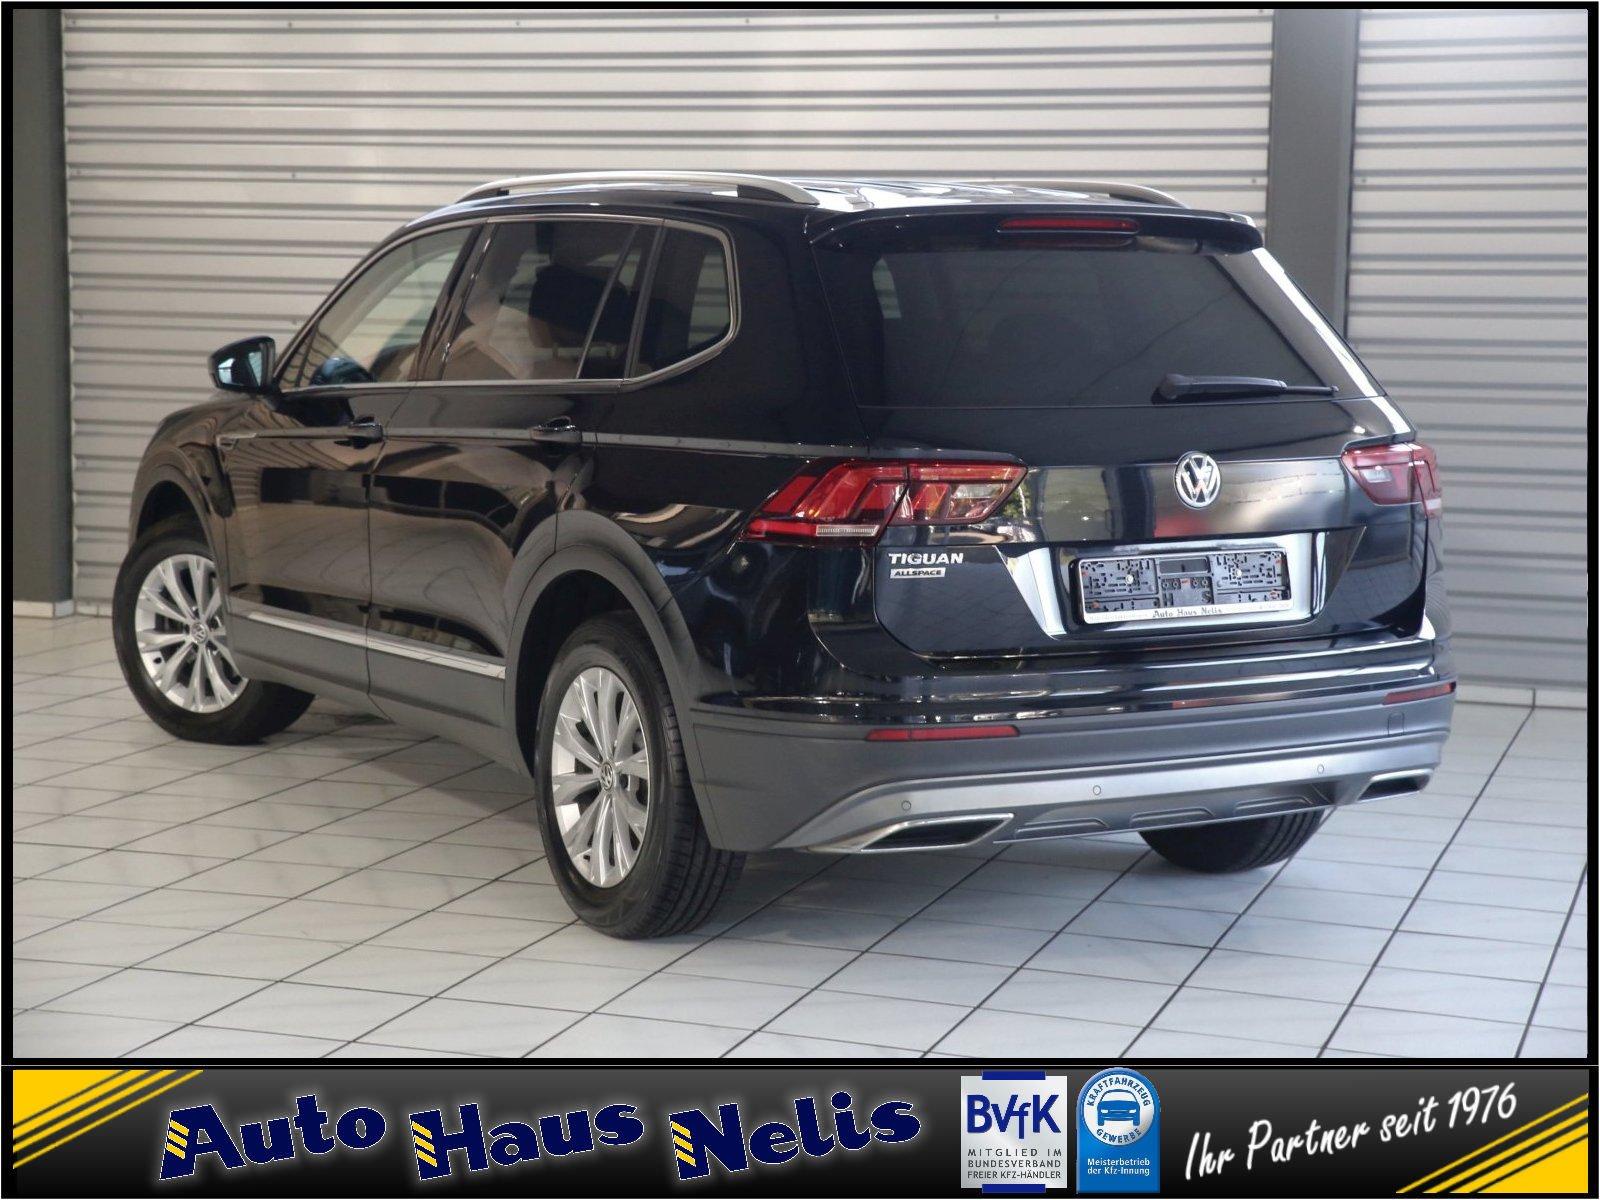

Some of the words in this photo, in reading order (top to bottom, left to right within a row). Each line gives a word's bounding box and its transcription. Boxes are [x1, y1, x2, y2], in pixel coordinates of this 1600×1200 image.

[888, 552, 964, 565] TIGUAN
[894, 569, 942, 577] ALLSPACE
[1152, 609, 1174, 619] Auto
[1177, 608, 1198, 617] Haus
[1201, 606, 1223, 616] Nelis
